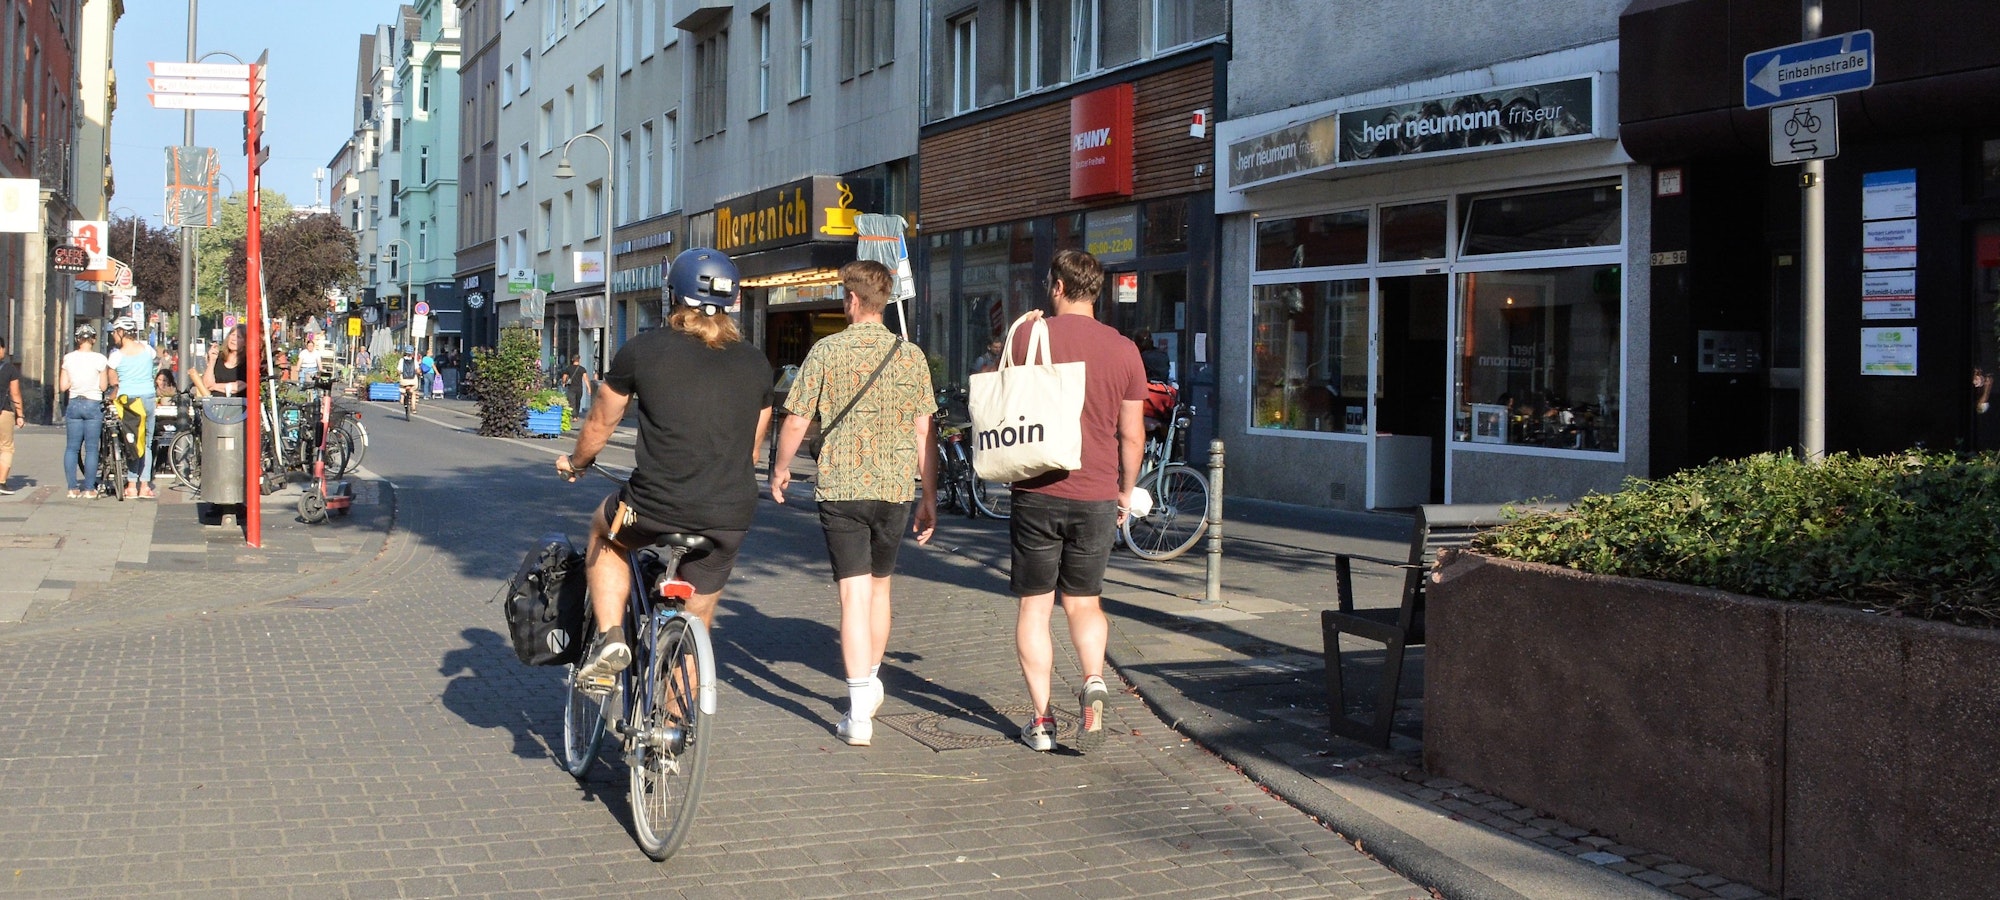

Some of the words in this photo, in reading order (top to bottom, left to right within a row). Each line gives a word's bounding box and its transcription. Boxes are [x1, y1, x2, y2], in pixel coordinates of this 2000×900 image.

[1778, 56, 1864, 82] Einbahnstraße
[1363, 120, 1402, 143] herr
[1406, 109, 1501, 137] neumann
[1508, 105, 1563, 125] friseur
[1238, 151, 1255, 170] herr
[1256, 142, 1296, 166] neumann
[1299, 139, 1322, 155] friseur
[717, 187, 807, 251] Merzenich
[979, 415, 1044, 451] moin
